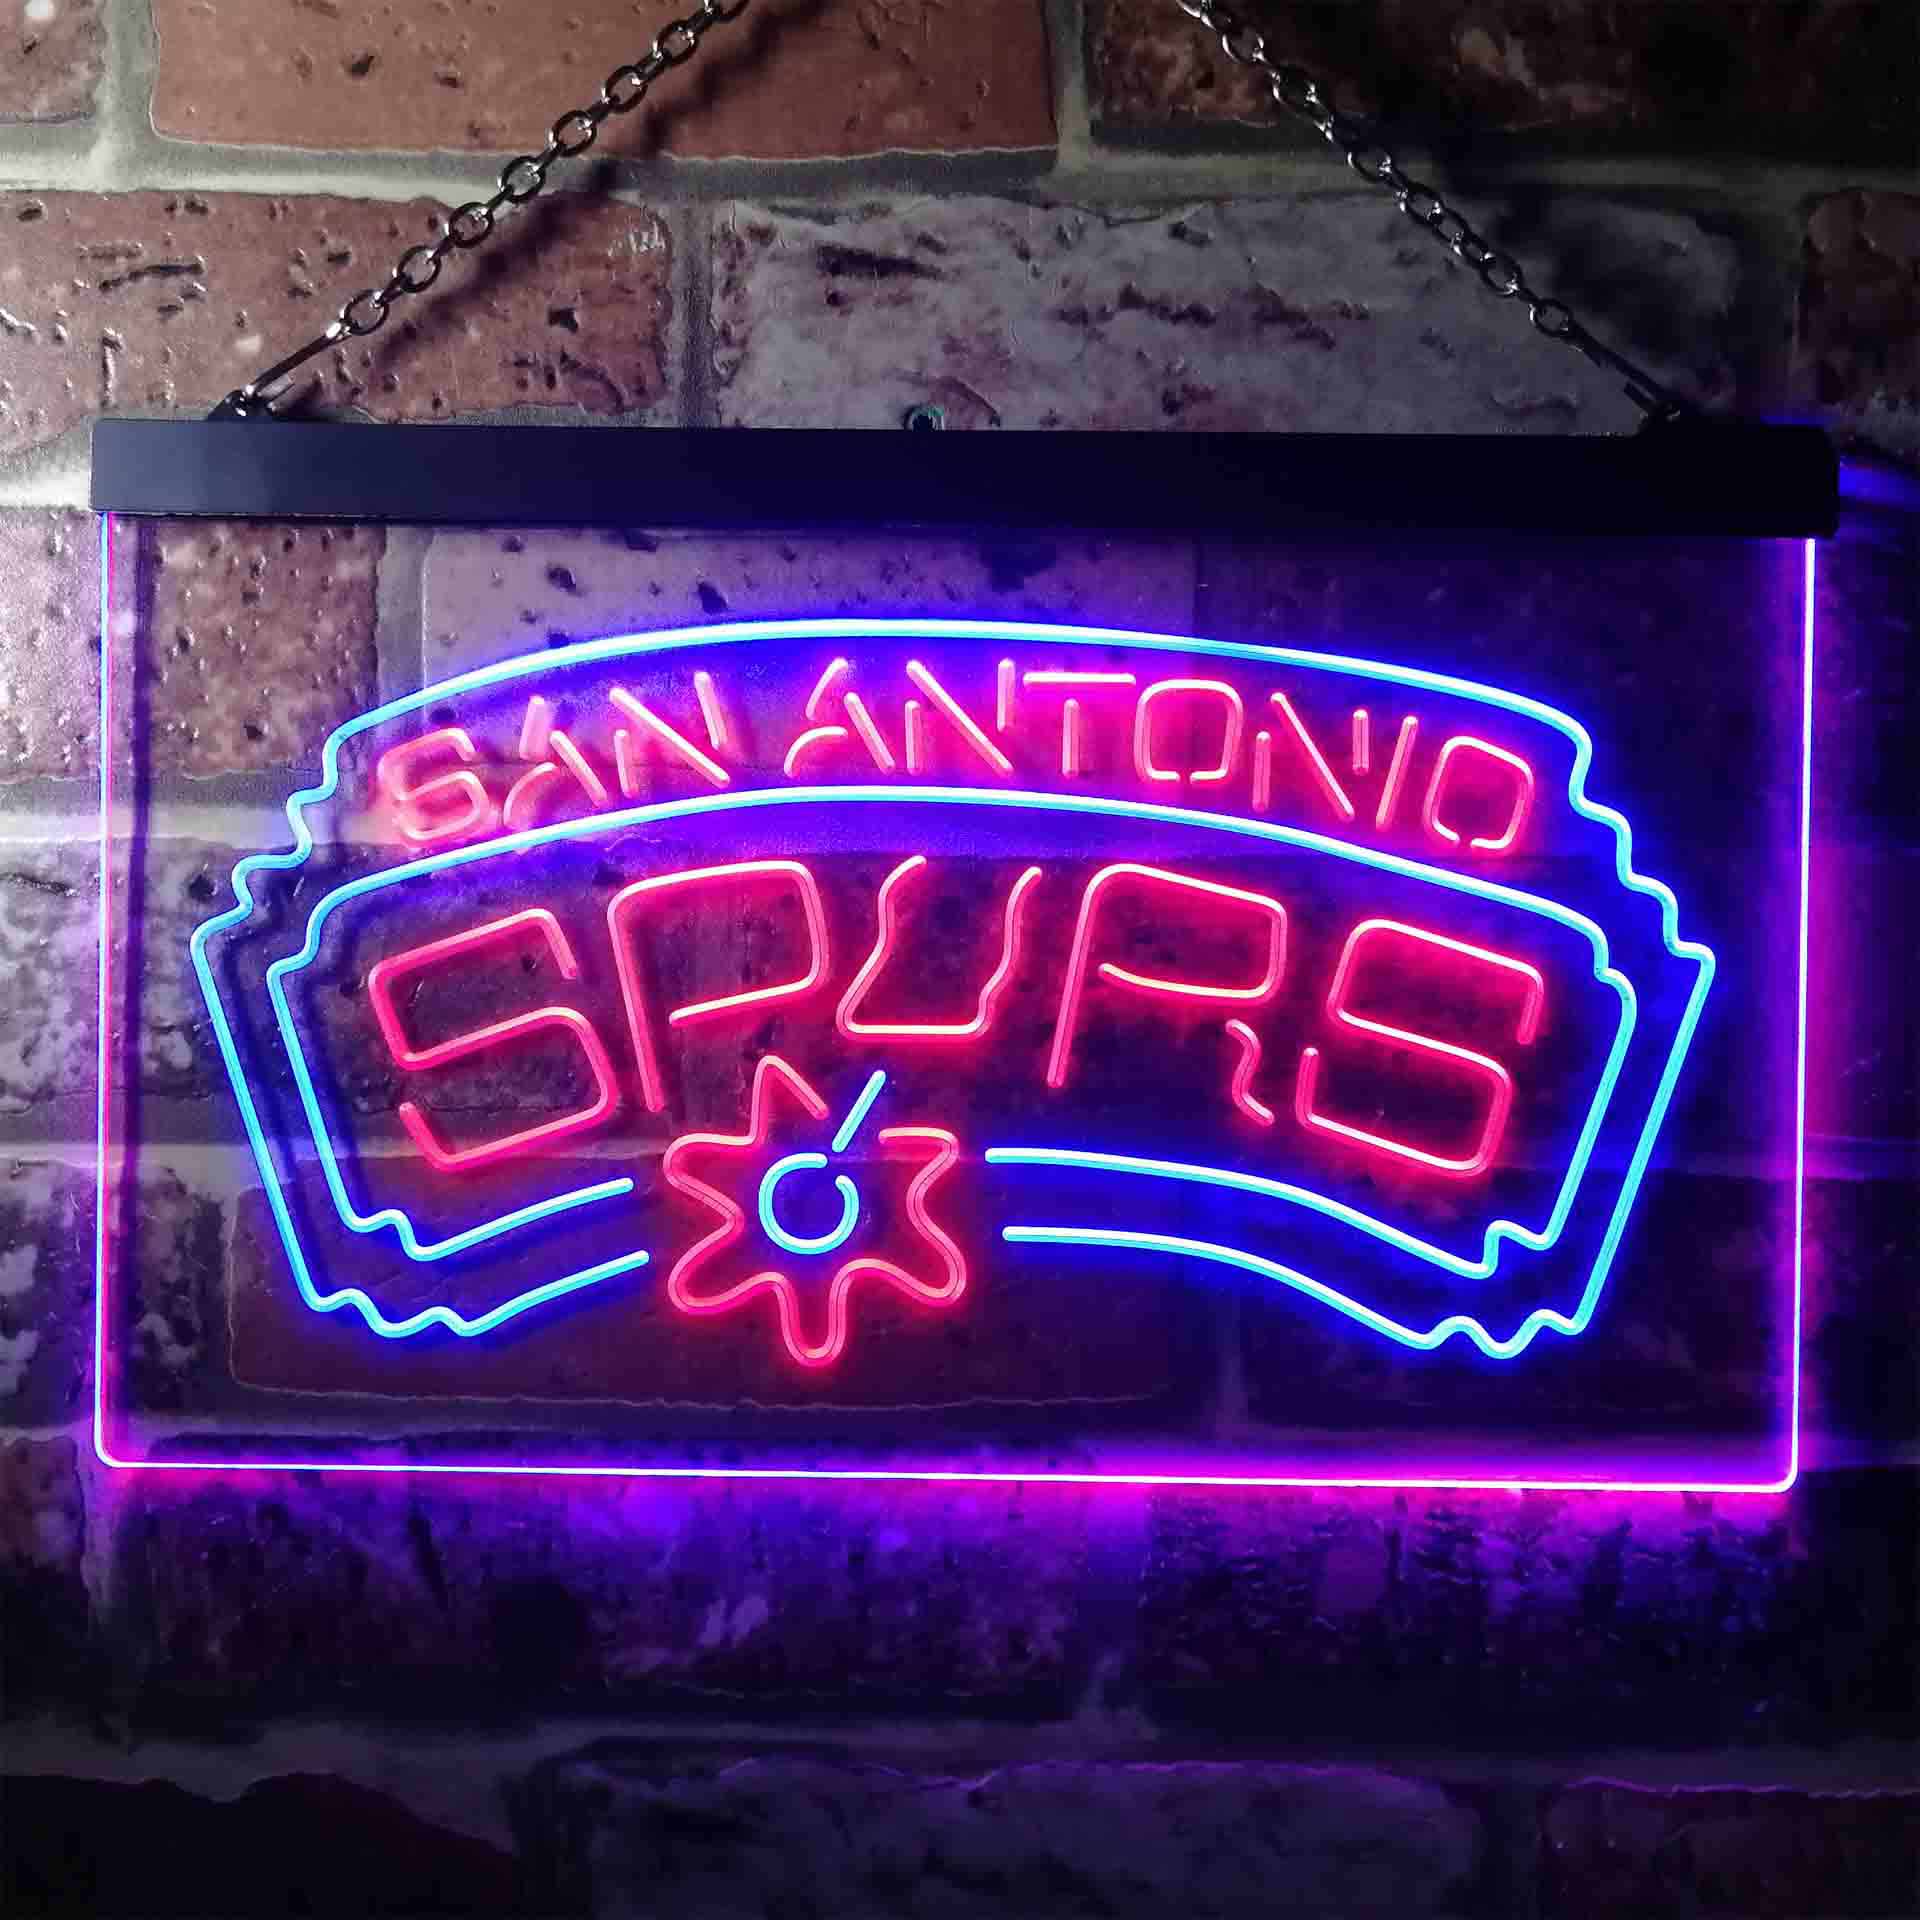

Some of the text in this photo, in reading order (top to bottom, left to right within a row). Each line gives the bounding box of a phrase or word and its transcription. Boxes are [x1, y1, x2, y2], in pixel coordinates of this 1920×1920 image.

[377, 657, 1534, 850] SAN ANTONIO
[367, 855, 1545, 1177] SPURS
